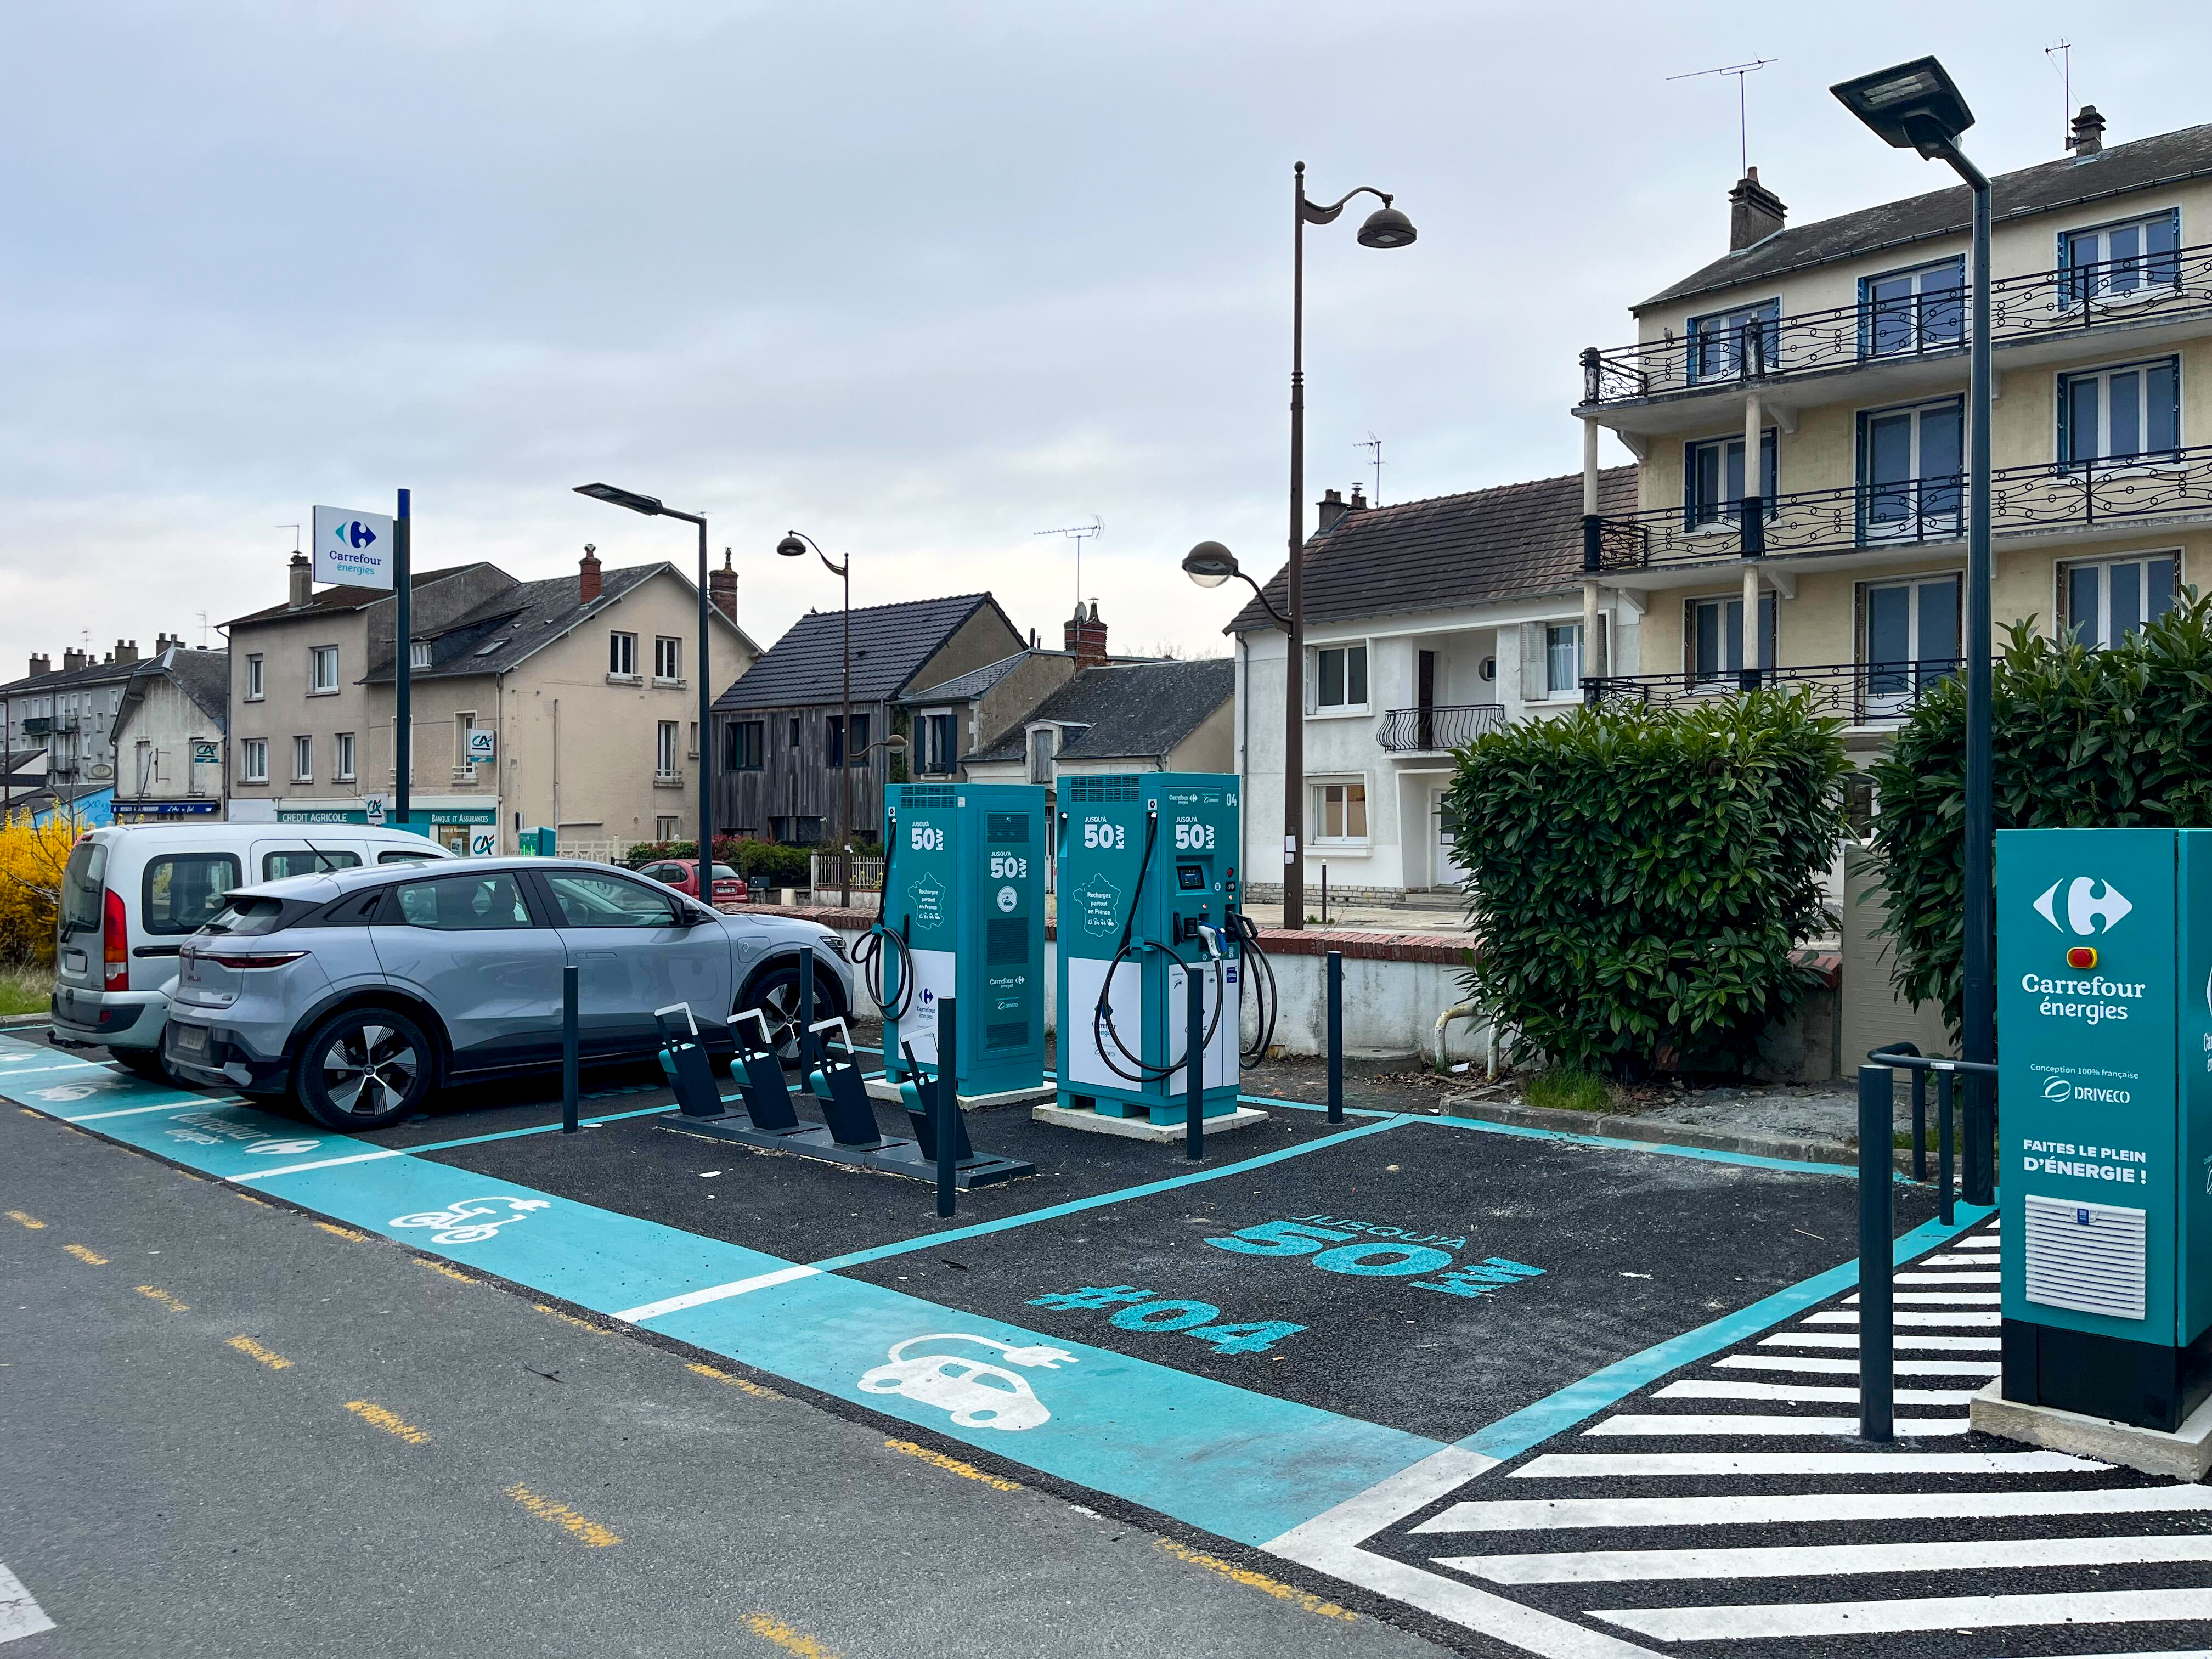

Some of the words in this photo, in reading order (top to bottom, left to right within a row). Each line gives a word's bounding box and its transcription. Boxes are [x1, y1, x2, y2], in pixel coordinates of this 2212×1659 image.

[329, 550, 382, 566] Carrefour
[337, 562, 375, 575] énergies
[1226, 793, 1237, 806] 04
[283, 813, 309, 822] CREDIT
[311, 812, 347, 822] AGRICOLE
[431, 814, 450, 823] BANQUE
[459, 814, 488, 822] ASSURANCES
[1176, 815, 1198, 823] JUSQU'À
[911, 828, 935, 850] 50
[1084, 824, 1114, 849] 50
[1175, 823, 1205, 849] 50
[990, 857, 1018, 879] 50
[2022, 974, 2146, 998] Carrefour
[917, 1006, 935, 1014] Carrefour
[2039, 996, 2128, 1025] énergies
[2030, 1064, 2075, 1074] Conception
[2101, 1069, 2139, 1079] française
[2074, 1086, 2130, 1103] DRIVECO
[2023, 1139, 2075, 1155] FAITES
[2079, 1146, 2097, 1158] LE
[2101, 1148, 2146, 1163] PLEIN
[2023, 1156, 2135, 1183] D'ÉNERGIE
[2140, 1170, 2147, 1184] !
[1203, 1221, 1453, 1276] 50
[1024, 1285, 1310, 1355] #04
